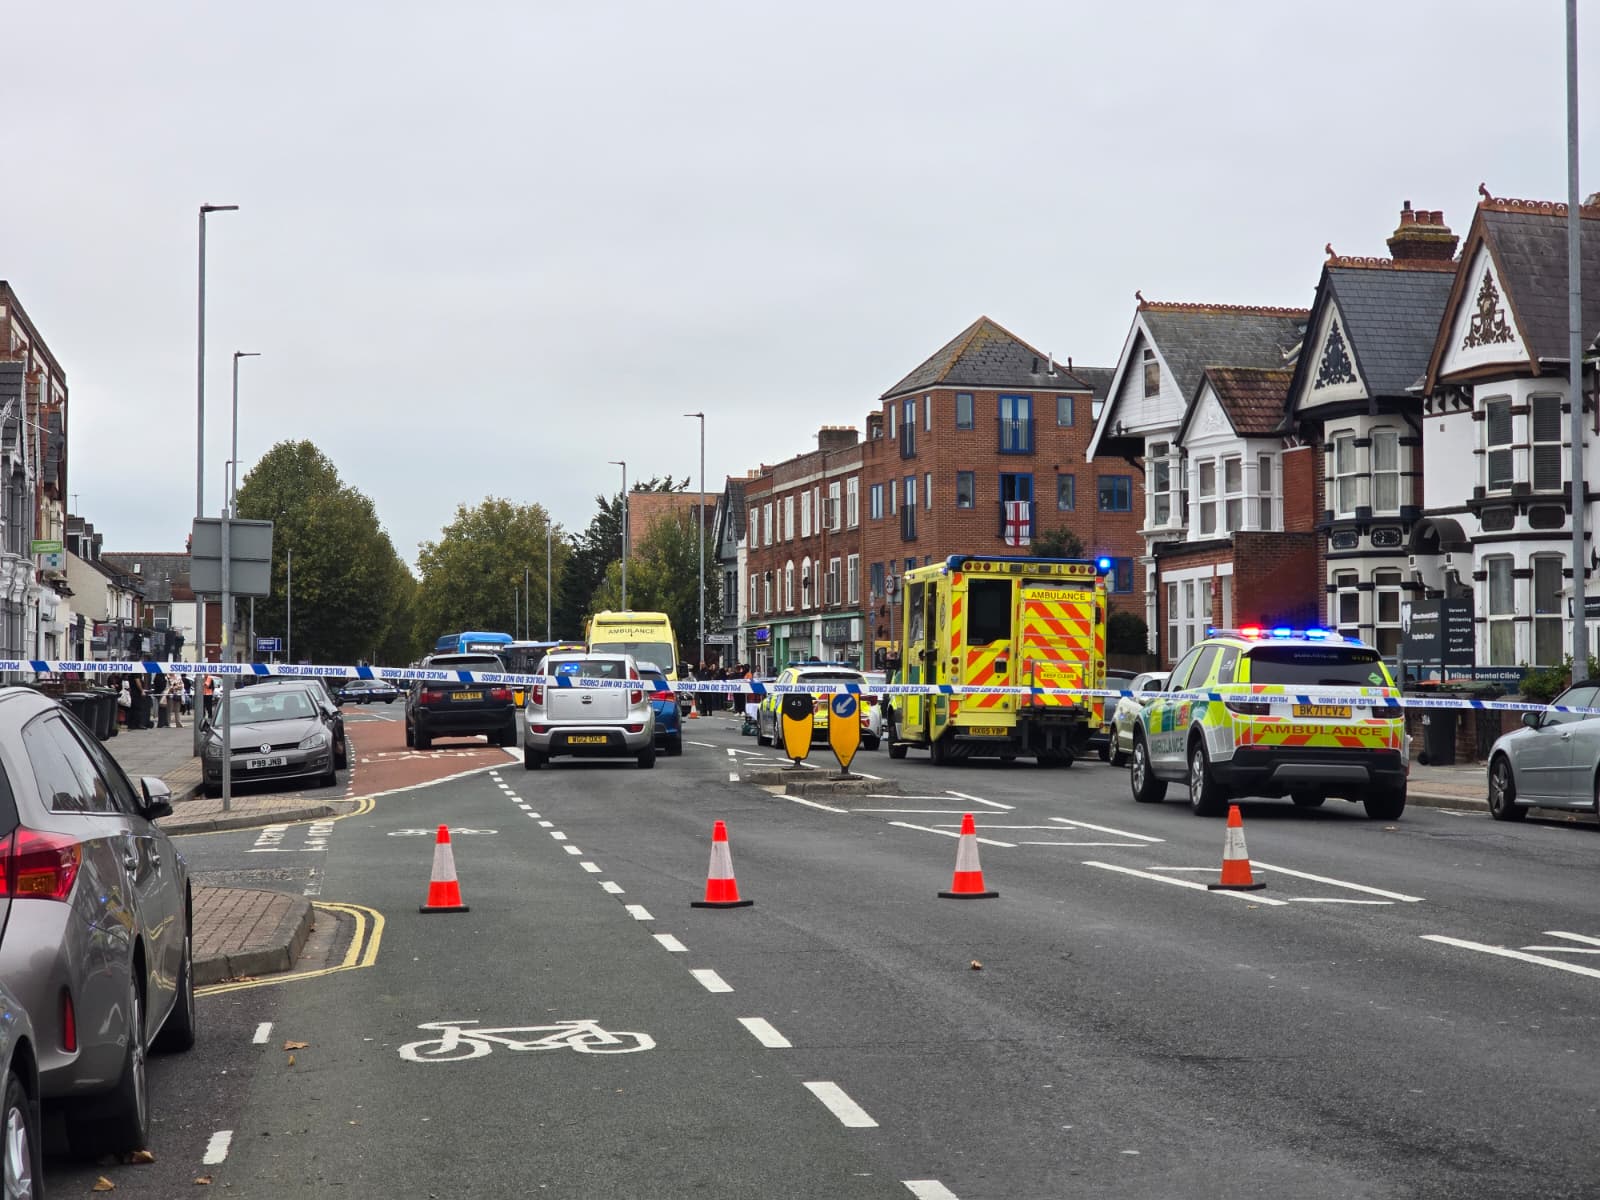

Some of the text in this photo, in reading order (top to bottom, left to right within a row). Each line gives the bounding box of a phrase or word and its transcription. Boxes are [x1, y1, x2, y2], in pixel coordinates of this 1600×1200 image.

[1031, 592, 1086, 600] AMBULANCE
[109, 664, 132, 672] POLICE
[482, 674, 502, 682] CROSS
[1300, 704, 1346, 716] BK71 CVZ
[1262, 724, 1383, 736] AMBULANCE
[1151, 737, 1184, 753] AMBULANCE
